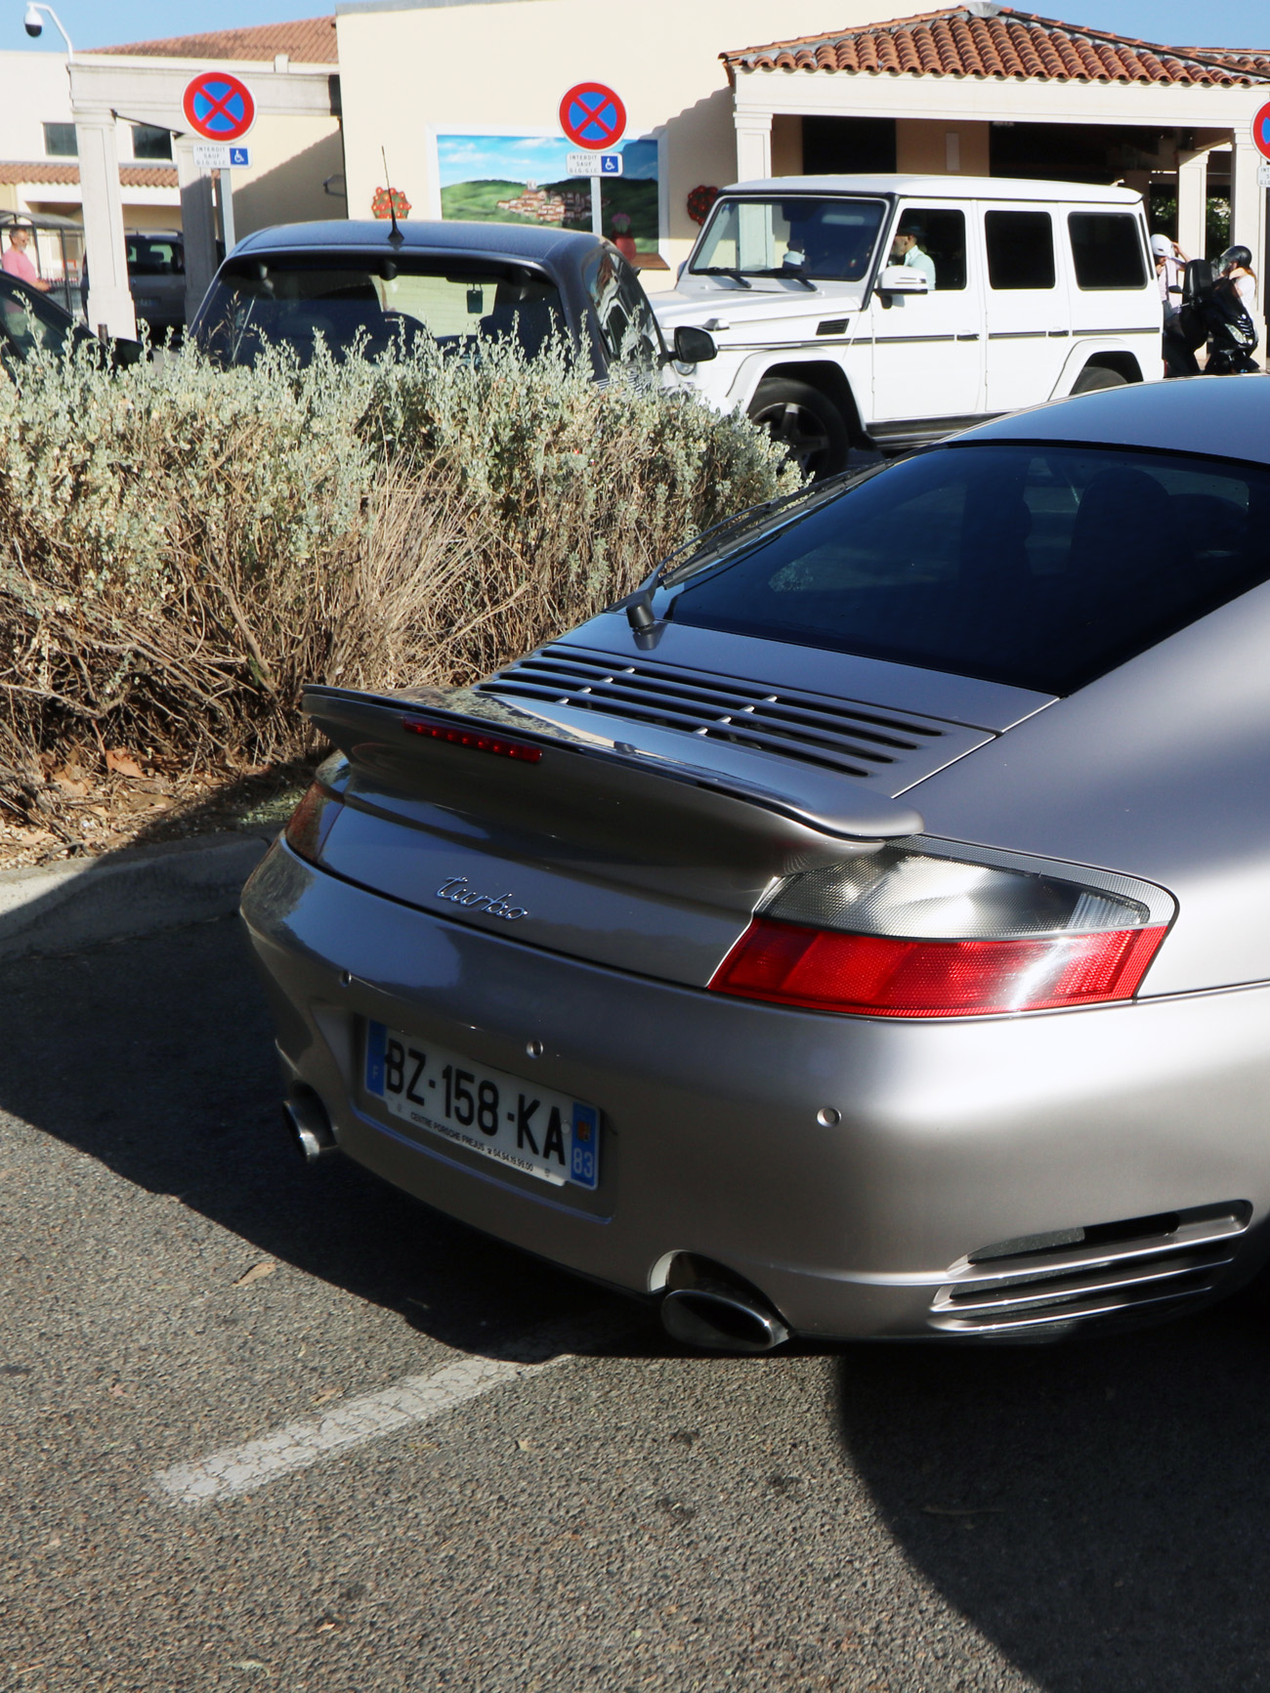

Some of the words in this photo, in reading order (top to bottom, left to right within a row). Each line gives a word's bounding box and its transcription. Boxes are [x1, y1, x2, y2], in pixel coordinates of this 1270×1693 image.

[410, 1111, 434, 1130] CENTRE
[433, 1121, 461, 1142] PORSCHE
[572, 1147, 594, 1179] 83
